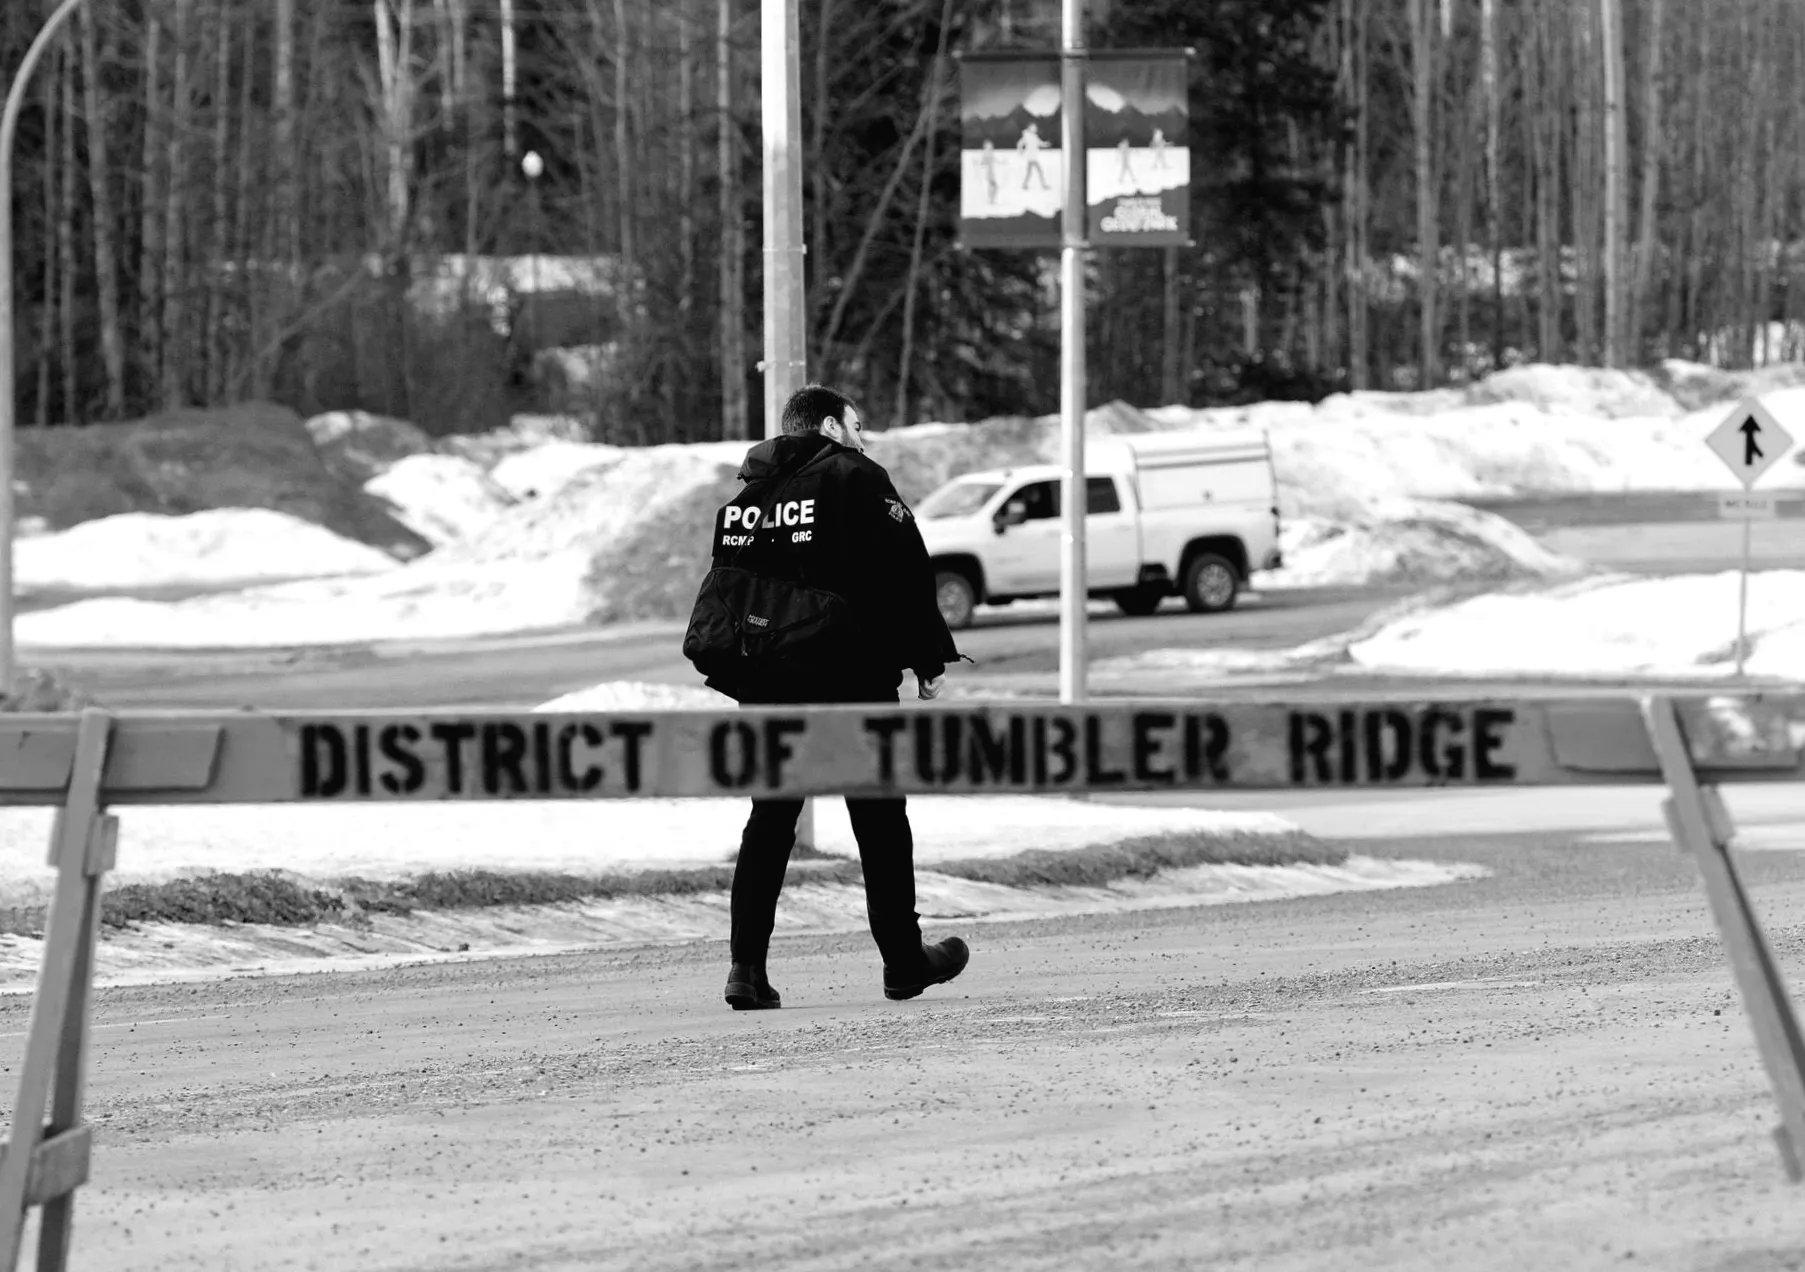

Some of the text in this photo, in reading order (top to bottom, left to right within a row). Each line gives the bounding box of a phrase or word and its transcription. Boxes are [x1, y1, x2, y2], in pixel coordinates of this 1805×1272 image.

[791, 530, 812, 543] GRC
[301, 708, 1516, 797] DISTRICT OF TUMBLER RIDGE
